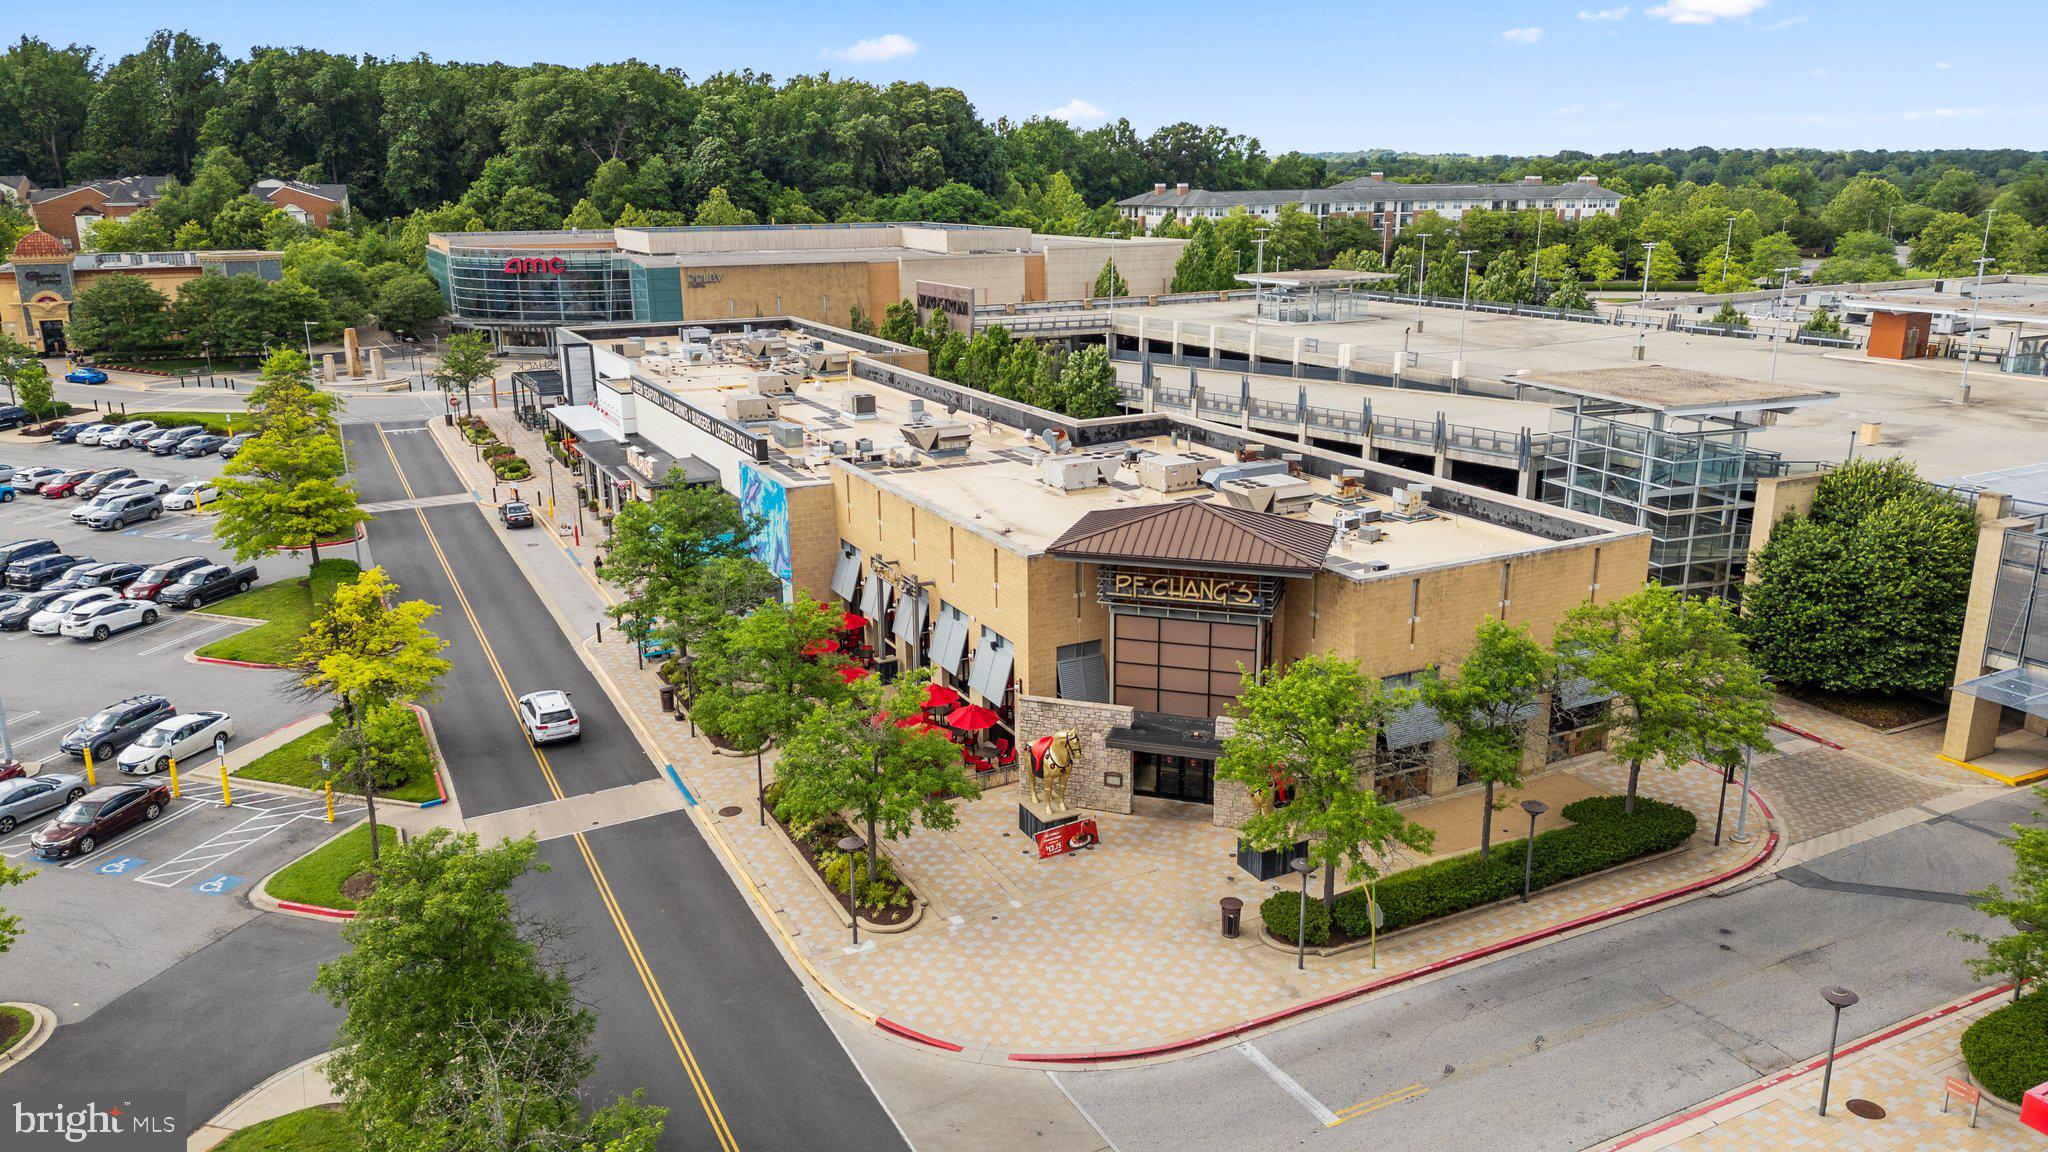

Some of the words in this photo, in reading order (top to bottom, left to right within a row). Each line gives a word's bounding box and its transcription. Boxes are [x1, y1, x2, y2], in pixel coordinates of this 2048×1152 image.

[663, 395, 674, 412] COLD
[691, 410, 711, 432] BURGERS
[714, 421, 736, 447] LOBSTER
[736, 433, 753, 455] ROLLS
[1152, 575, 1253, 606] CHANG'S
